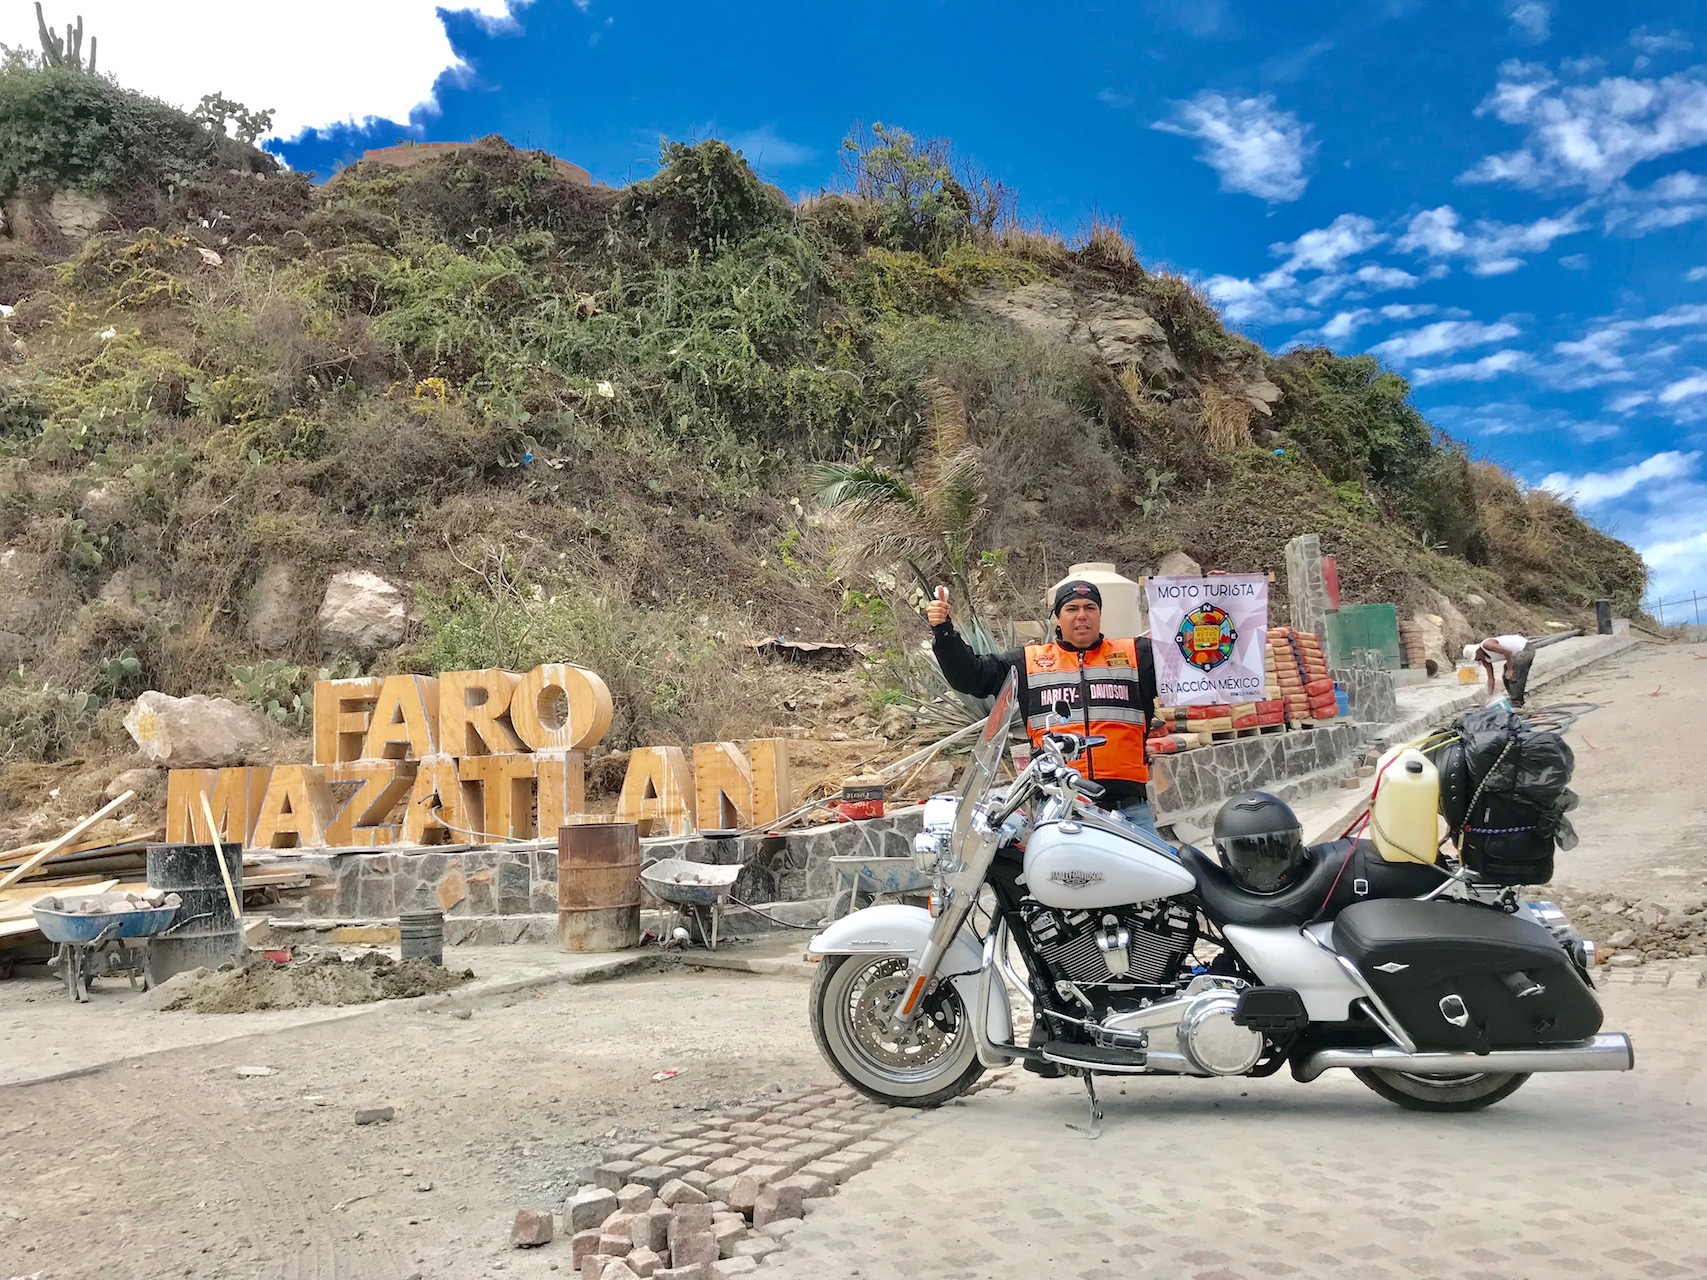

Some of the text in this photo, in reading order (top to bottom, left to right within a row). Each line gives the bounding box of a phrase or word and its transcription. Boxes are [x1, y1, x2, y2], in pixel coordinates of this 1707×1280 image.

[1158, 583, 1254, 598] MOTO TURISTA
[1090, 684, 1129, 701] DAVIDSON
[1161, 676, 1260, 694] EN ACCIÓN MÉXICO
[313, 663, 614, 766] FARO
[167, 737, 789, 849] MAZATLAN
